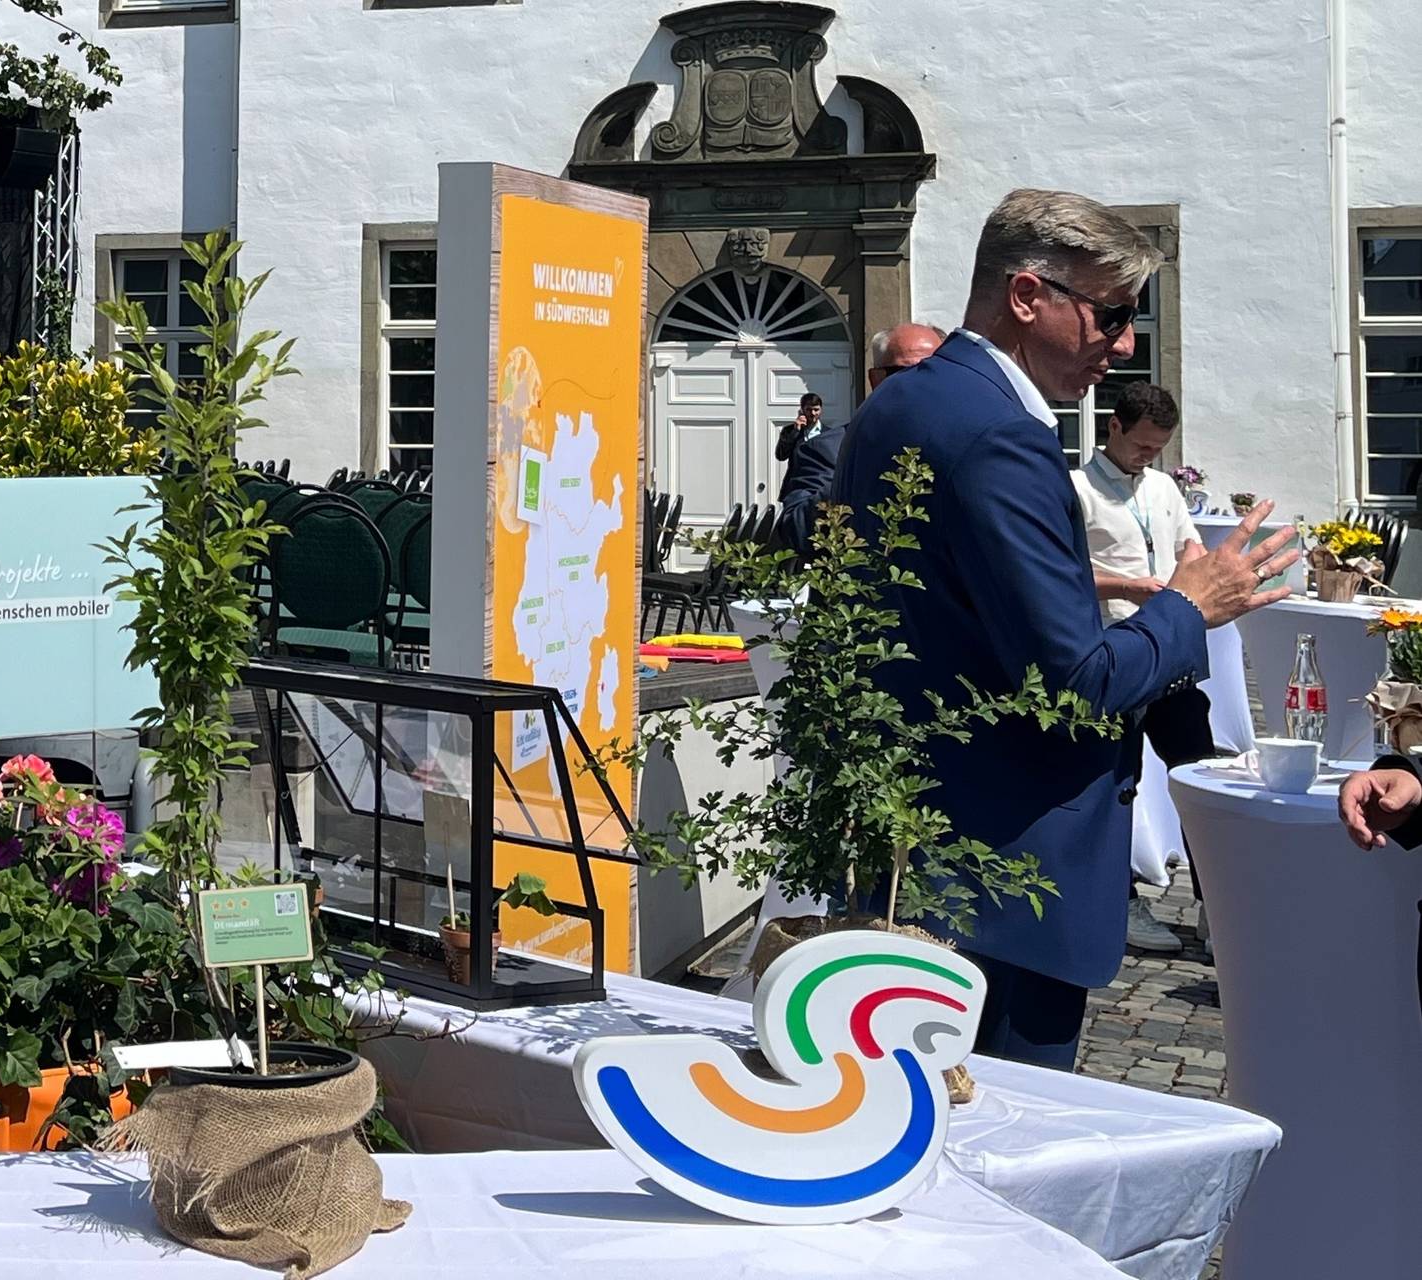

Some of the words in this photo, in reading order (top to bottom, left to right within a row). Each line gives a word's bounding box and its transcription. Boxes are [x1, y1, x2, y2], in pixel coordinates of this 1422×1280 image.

[533, 262, 614, 298] WILLKOMMEN
[534, 301, 545, 321] IN
[546, 296, 610, 327] SÜDWESTFALEN
[56, 600, 110, 617] mobiler
